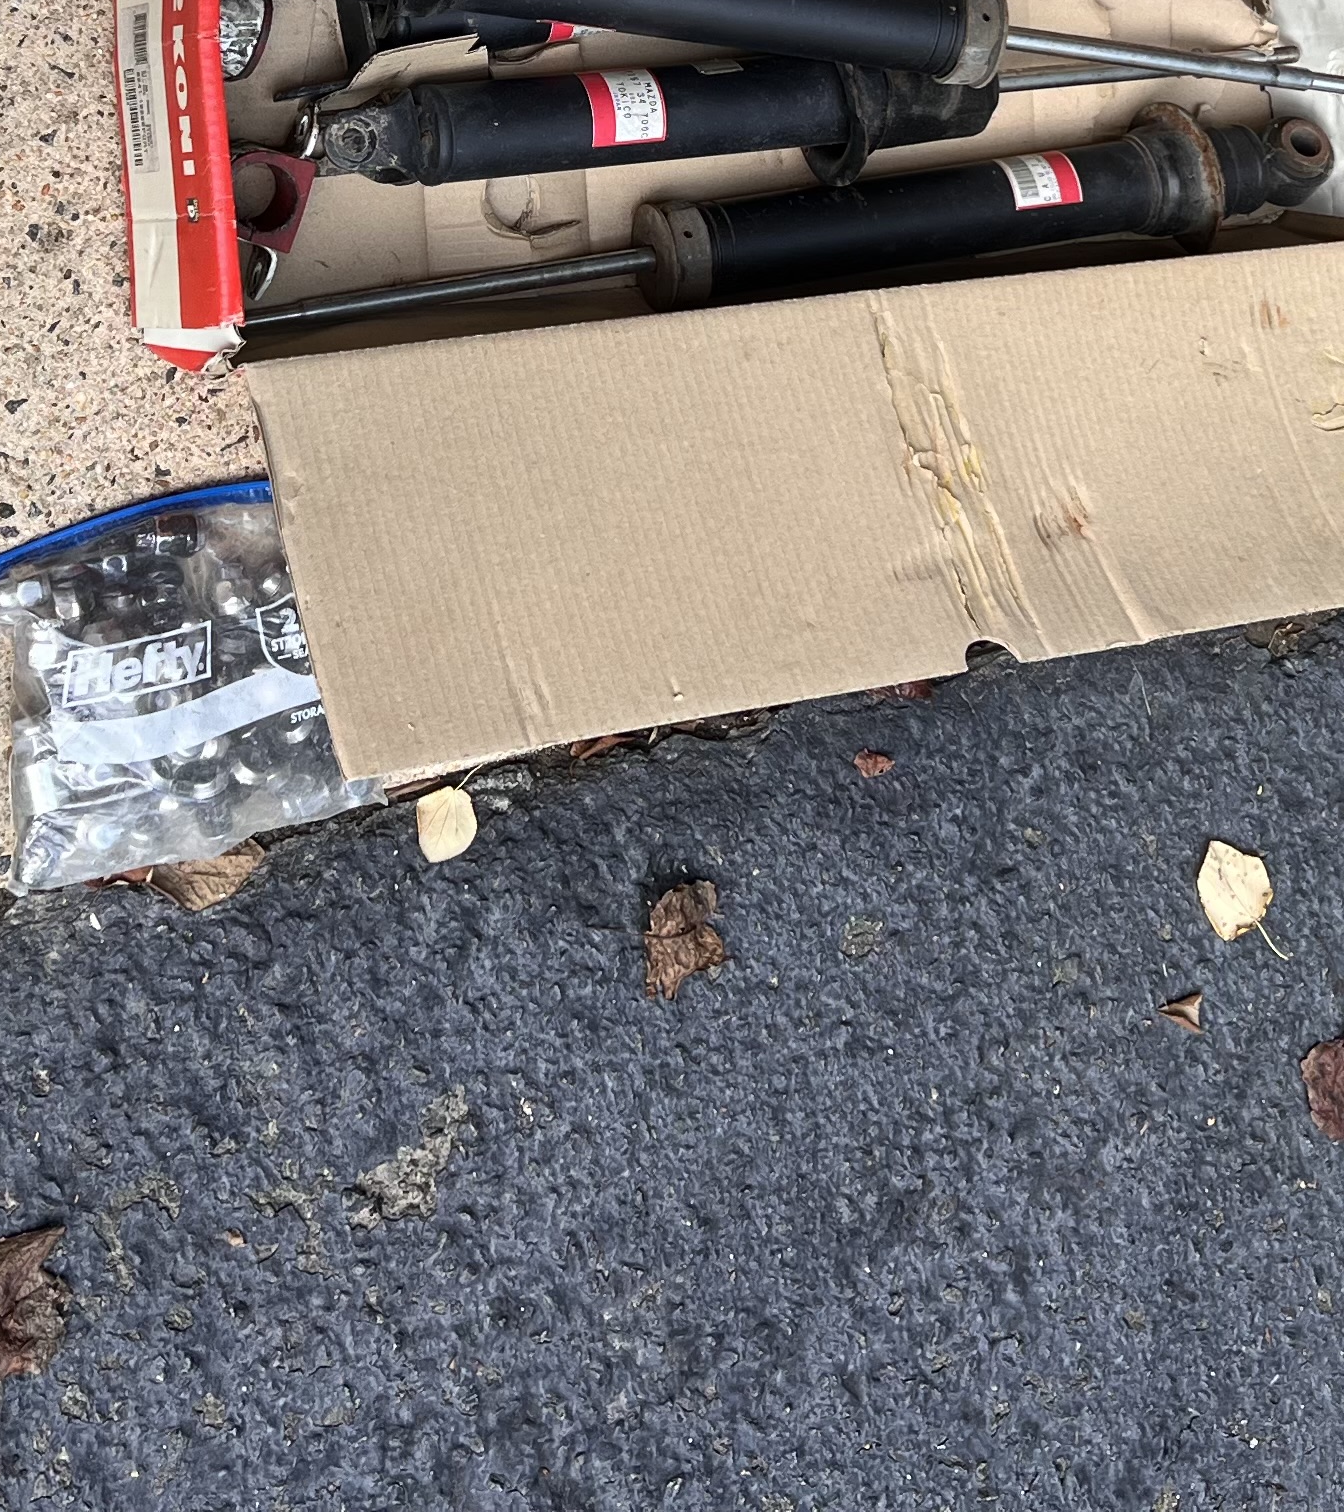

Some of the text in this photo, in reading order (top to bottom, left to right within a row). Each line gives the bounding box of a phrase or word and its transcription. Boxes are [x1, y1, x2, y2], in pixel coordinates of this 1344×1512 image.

[172, 24, 196, 176] KONI
[616, 82, 632, 118] TOKICO
[644, 82, 658, 113] MAZDA
